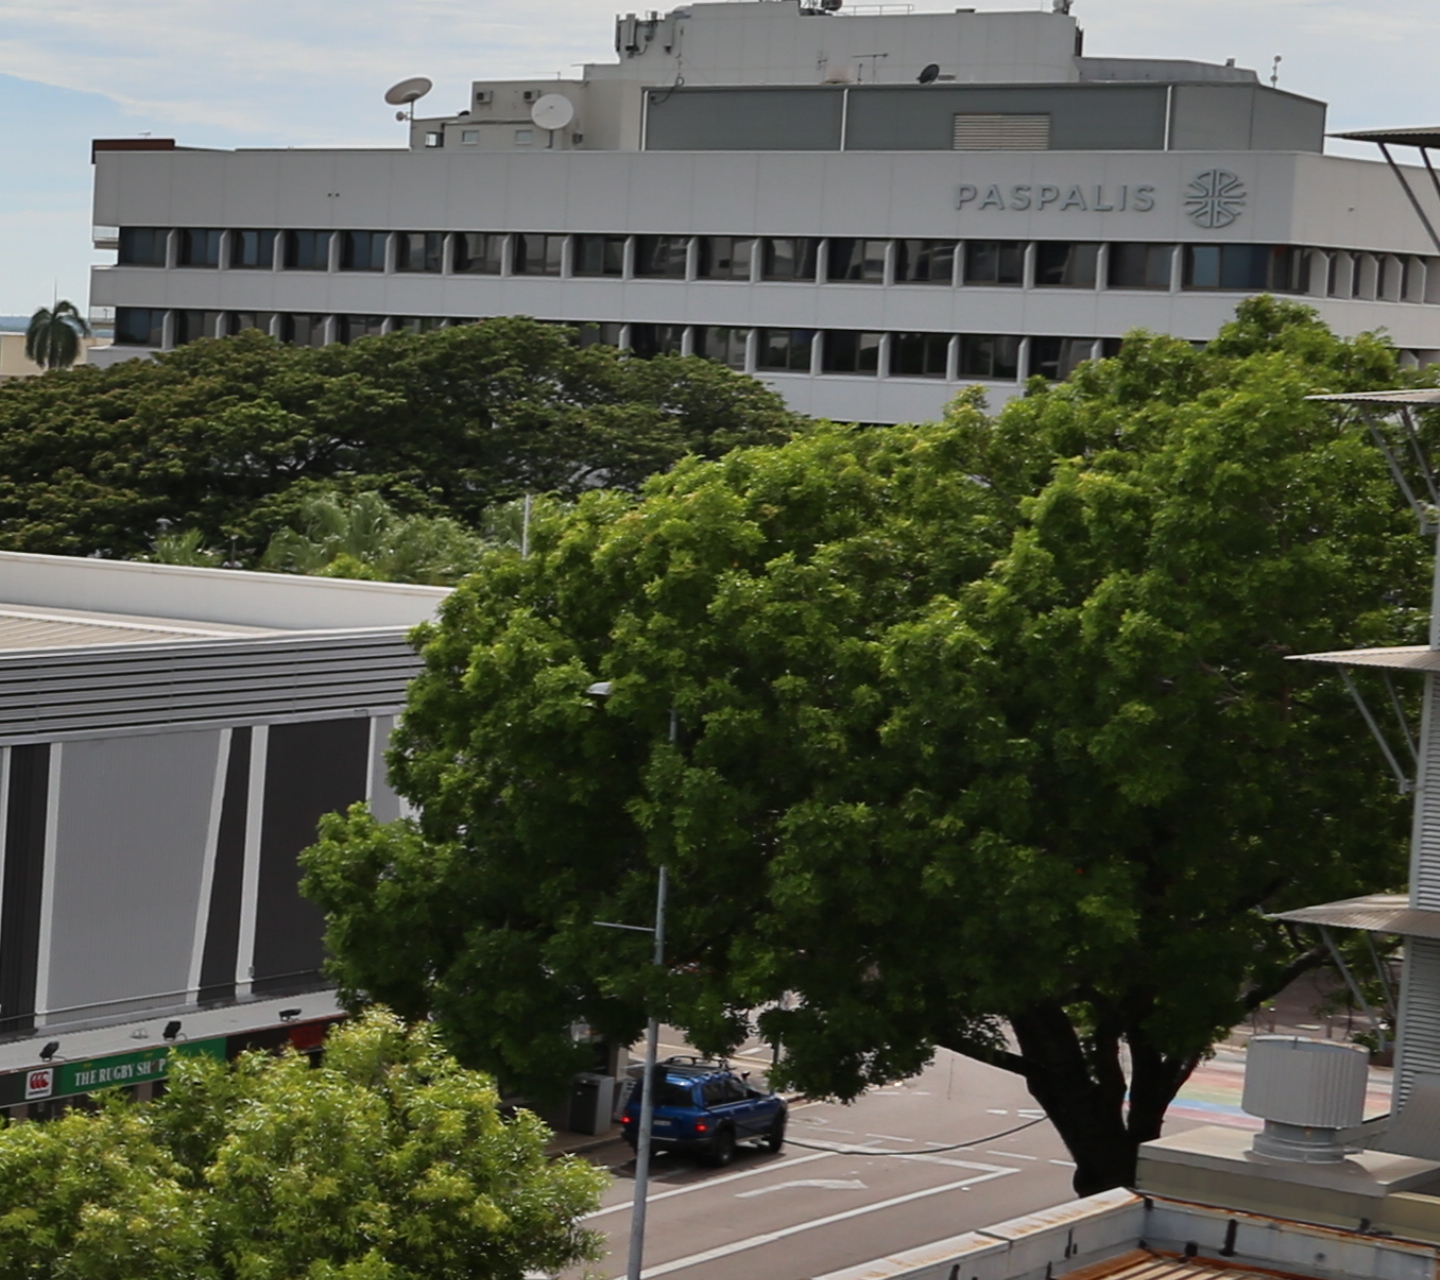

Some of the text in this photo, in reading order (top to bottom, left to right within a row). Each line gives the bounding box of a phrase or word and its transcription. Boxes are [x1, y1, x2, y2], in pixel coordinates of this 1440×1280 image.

[955, 184, 1155, 213] PASPALIS
[75, 1070, 97, 1086] THE
[99, 1064, 134, 1083] RUGBY
